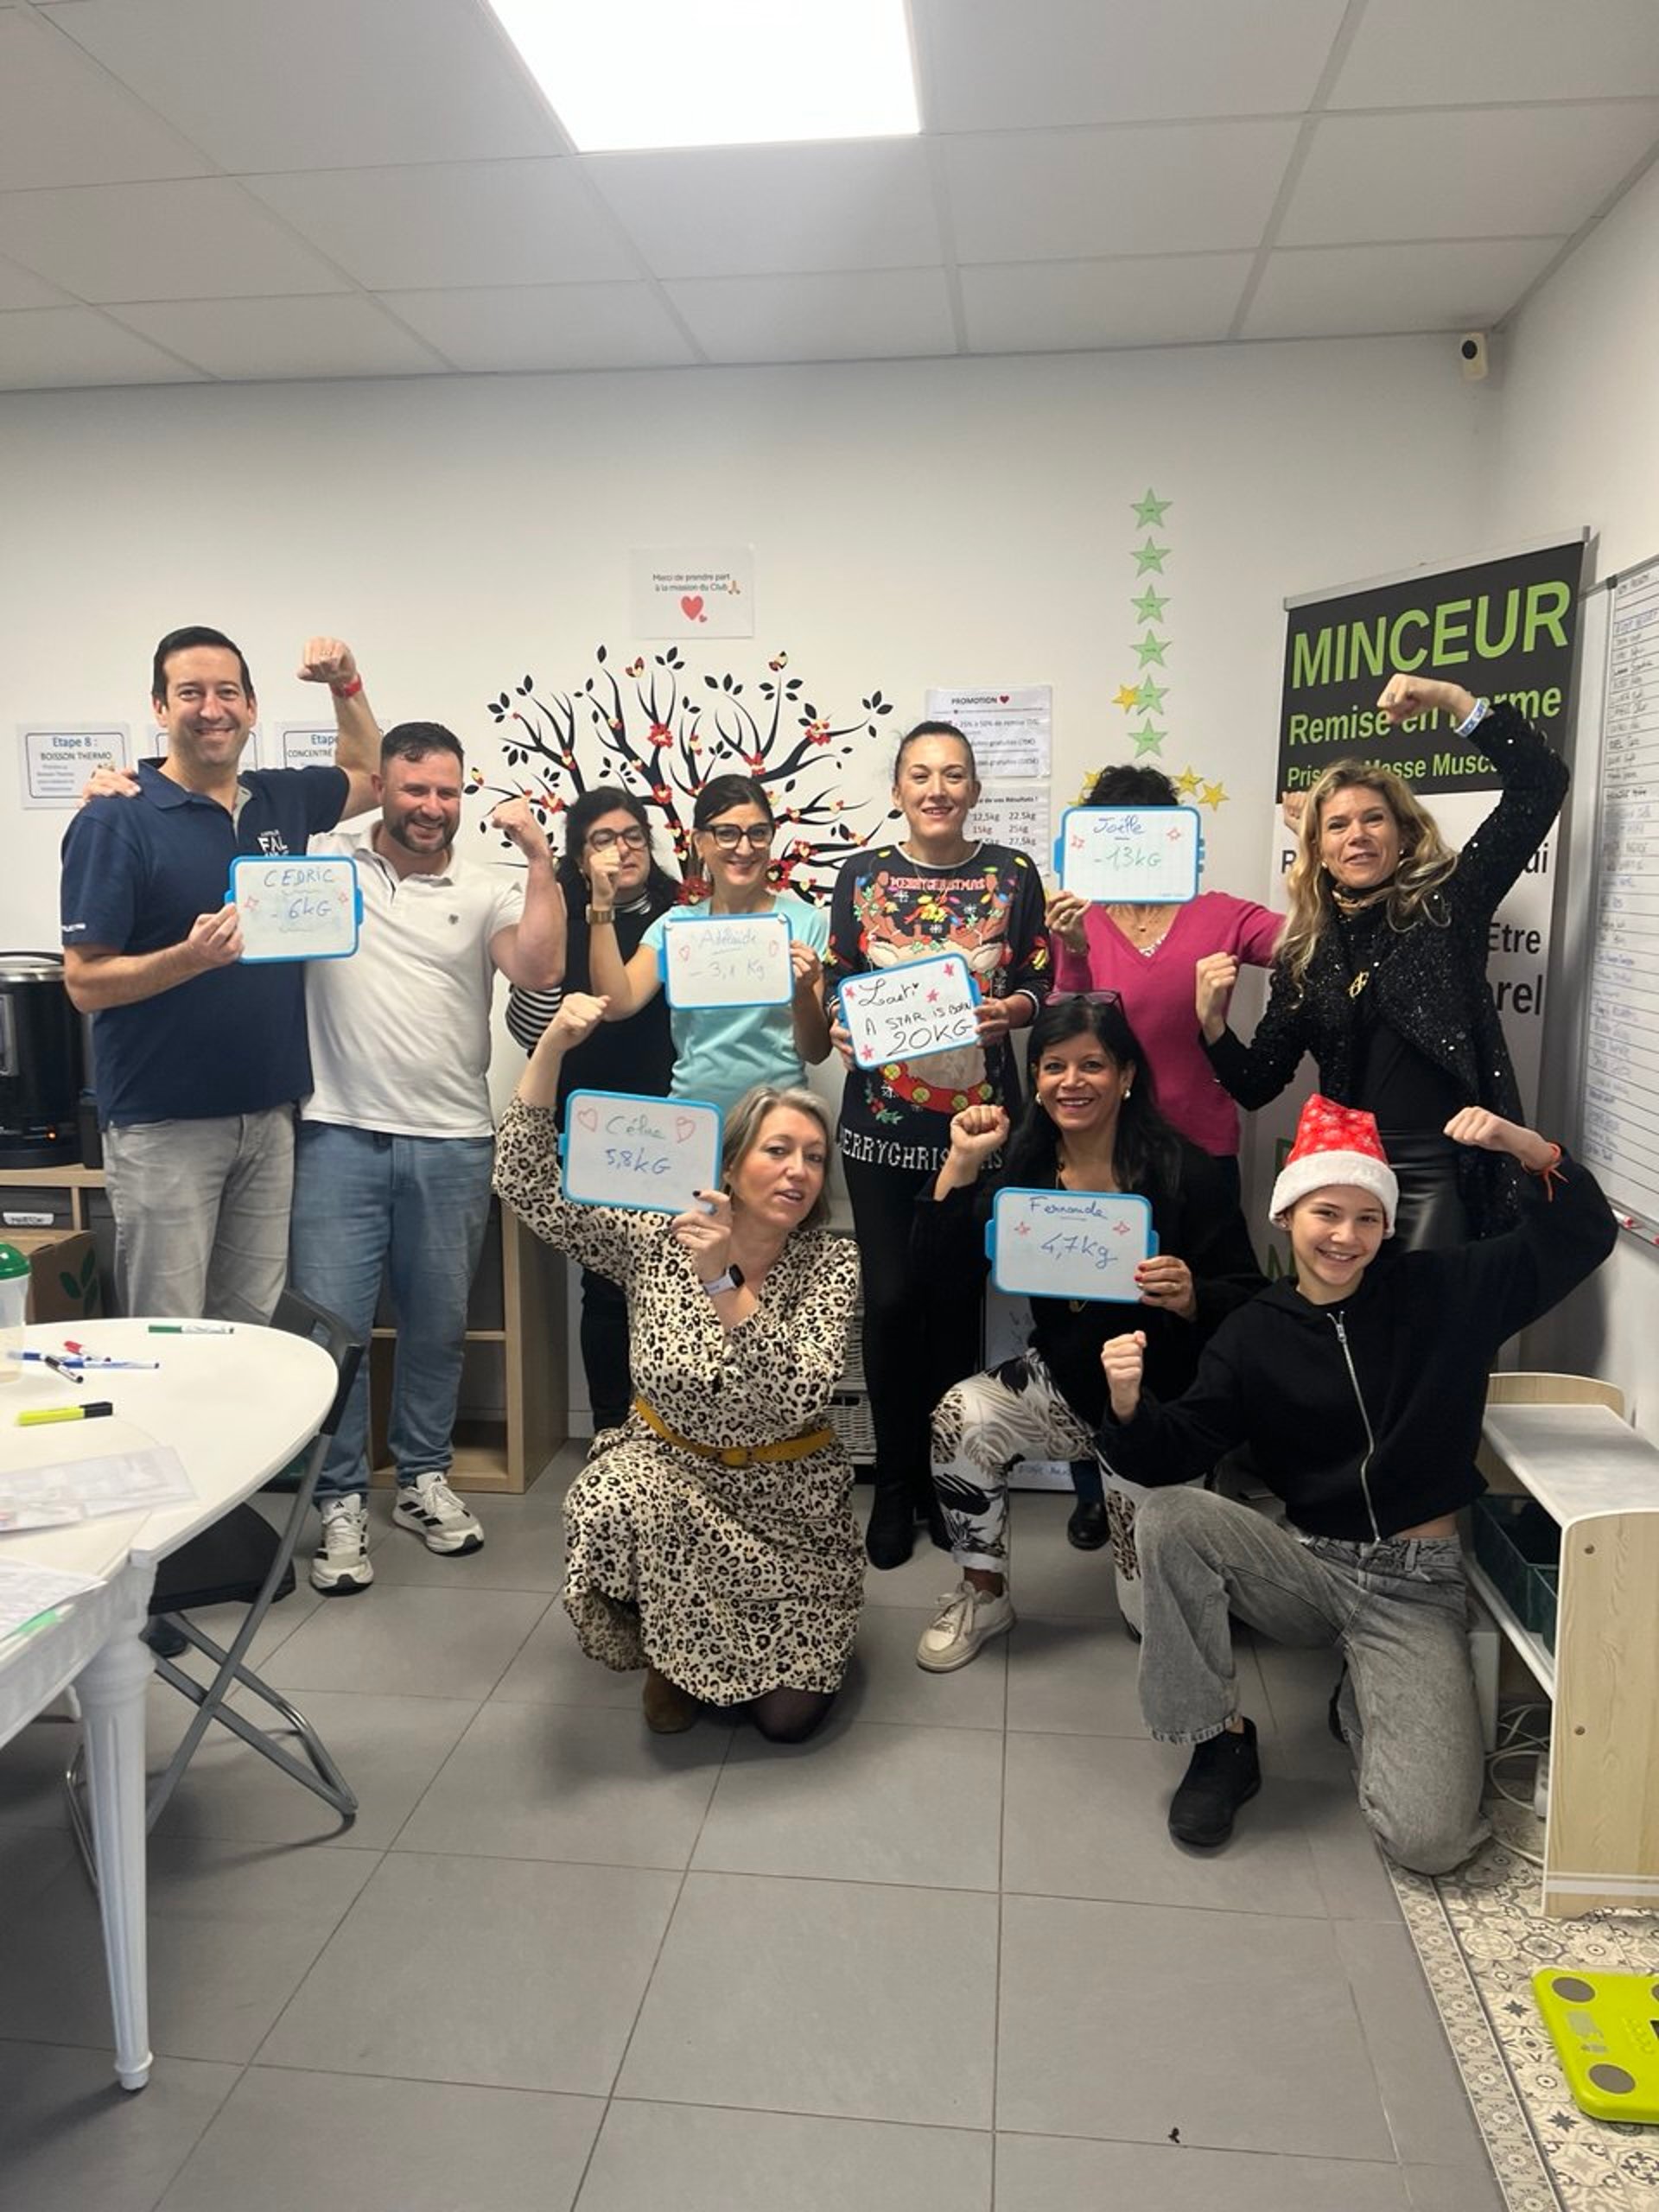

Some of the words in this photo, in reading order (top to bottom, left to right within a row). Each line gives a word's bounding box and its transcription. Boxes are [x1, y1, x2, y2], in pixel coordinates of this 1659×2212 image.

[1292, 581, 1570, 690] MINCEUR
[85, 736, 92, 747] 8
[1288, 705, 1392, 745] Remise
[885, 1012, 926, 1030] STAR
[887, 1020, 973, 1057] 20KG
